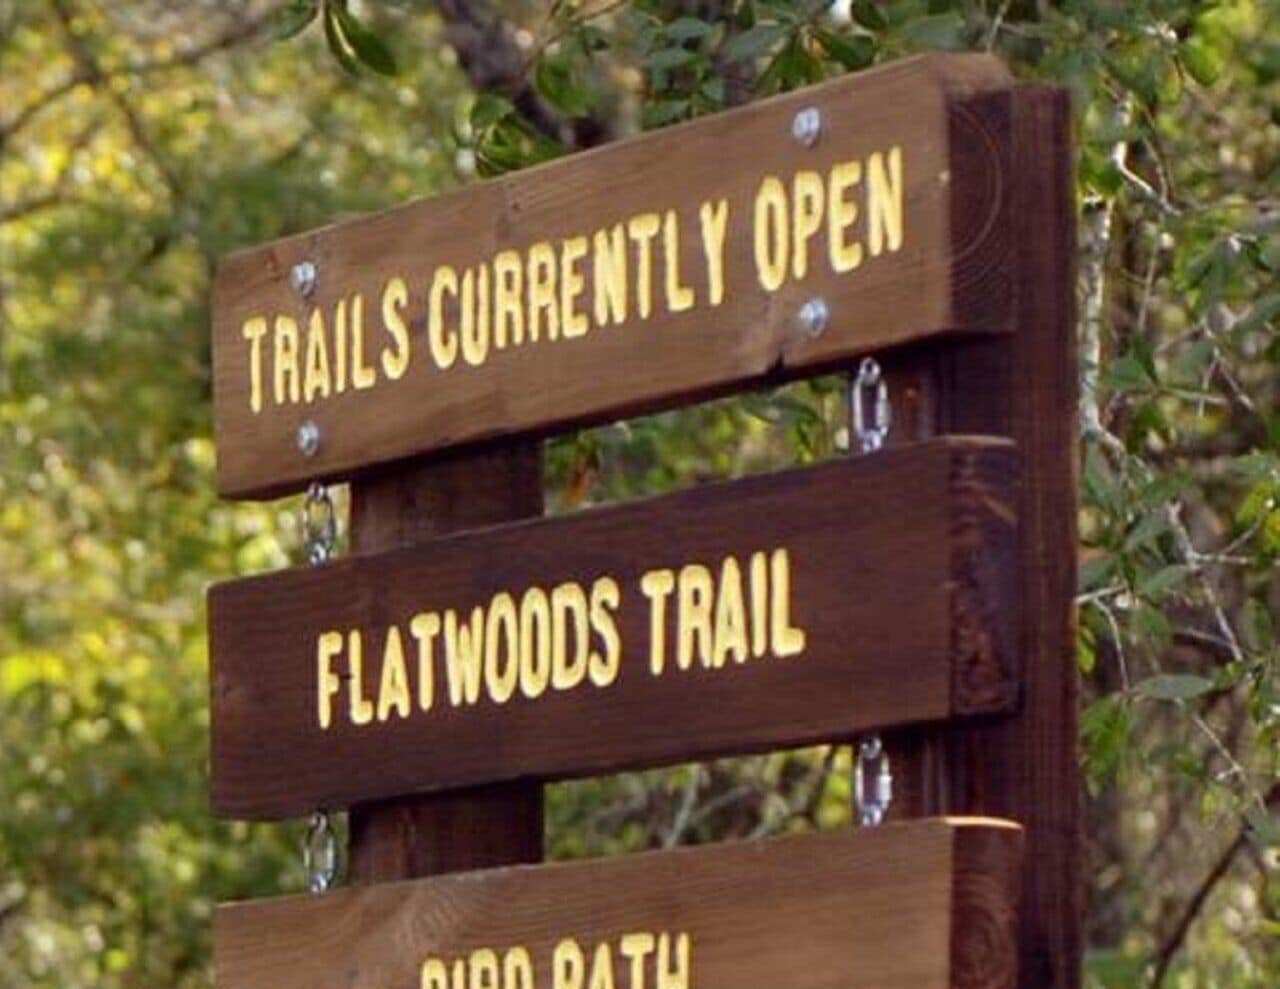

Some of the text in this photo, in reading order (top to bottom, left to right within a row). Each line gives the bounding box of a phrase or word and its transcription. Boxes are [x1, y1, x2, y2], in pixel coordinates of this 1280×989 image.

[240, 145, 904, 415] TRAILS CURRENTLY OPEN
[317, 548, 806, 730] FLATWOODS TRAIL
